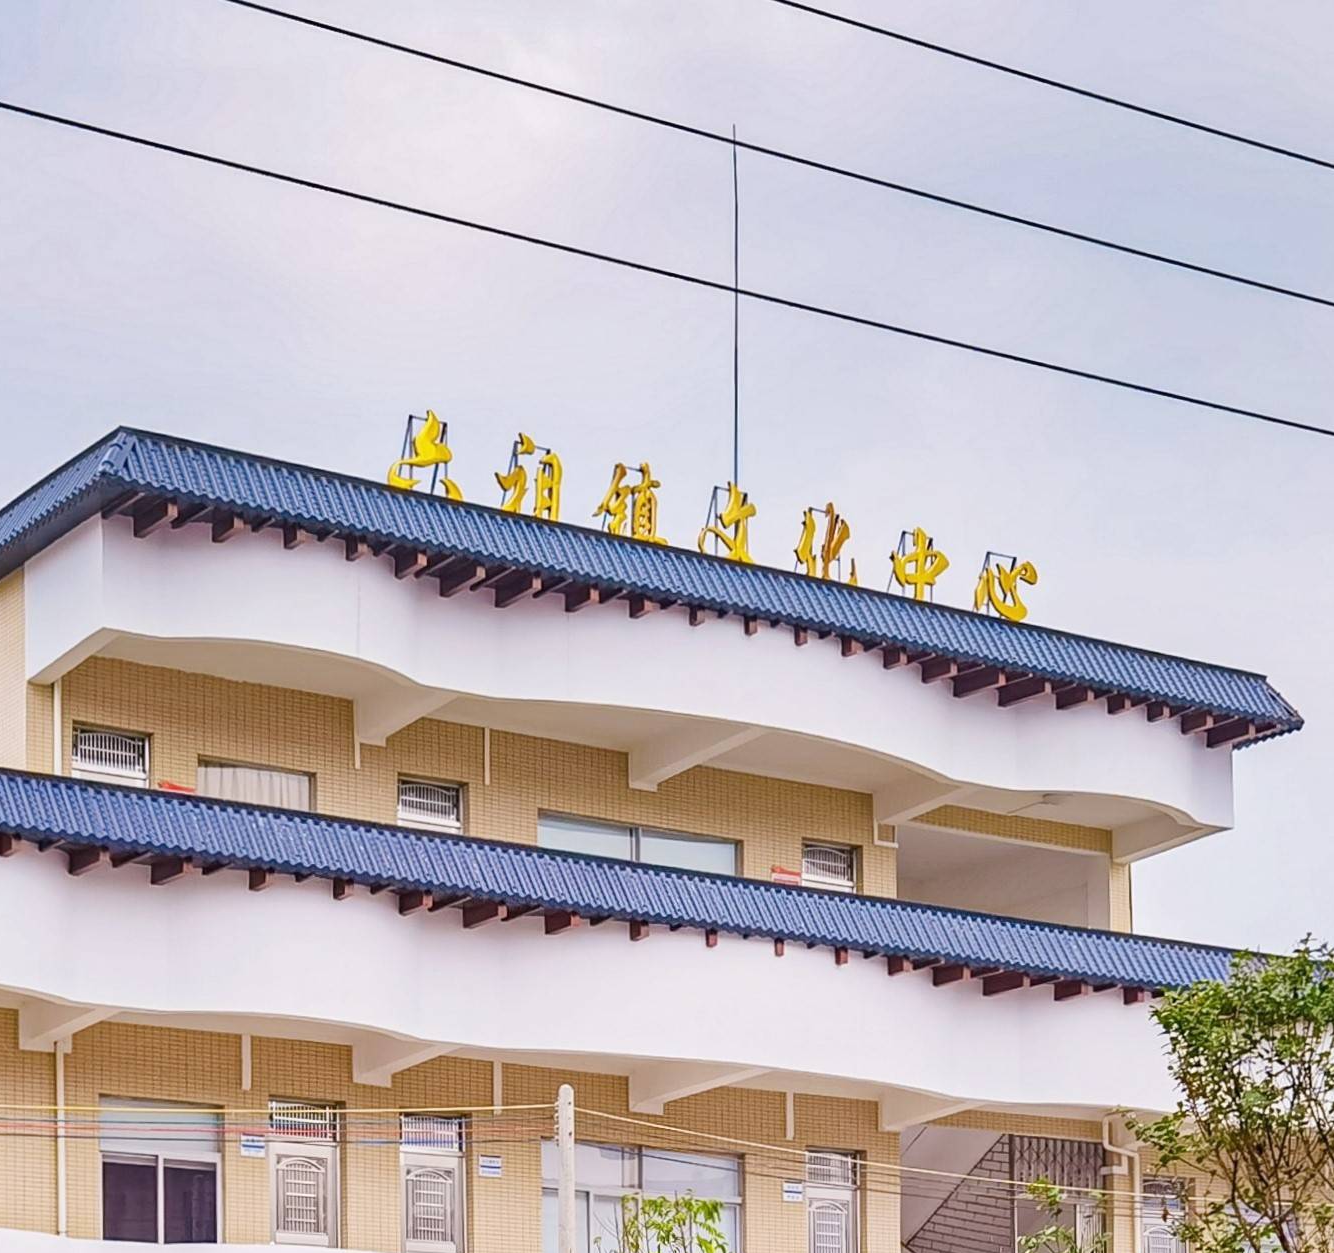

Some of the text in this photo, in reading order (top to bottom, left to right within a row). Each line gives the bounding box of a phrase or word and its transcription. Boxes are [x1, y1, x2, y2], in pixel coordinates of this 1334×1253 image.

[388, 409, 1038, 623] 六祖镇文化中心
